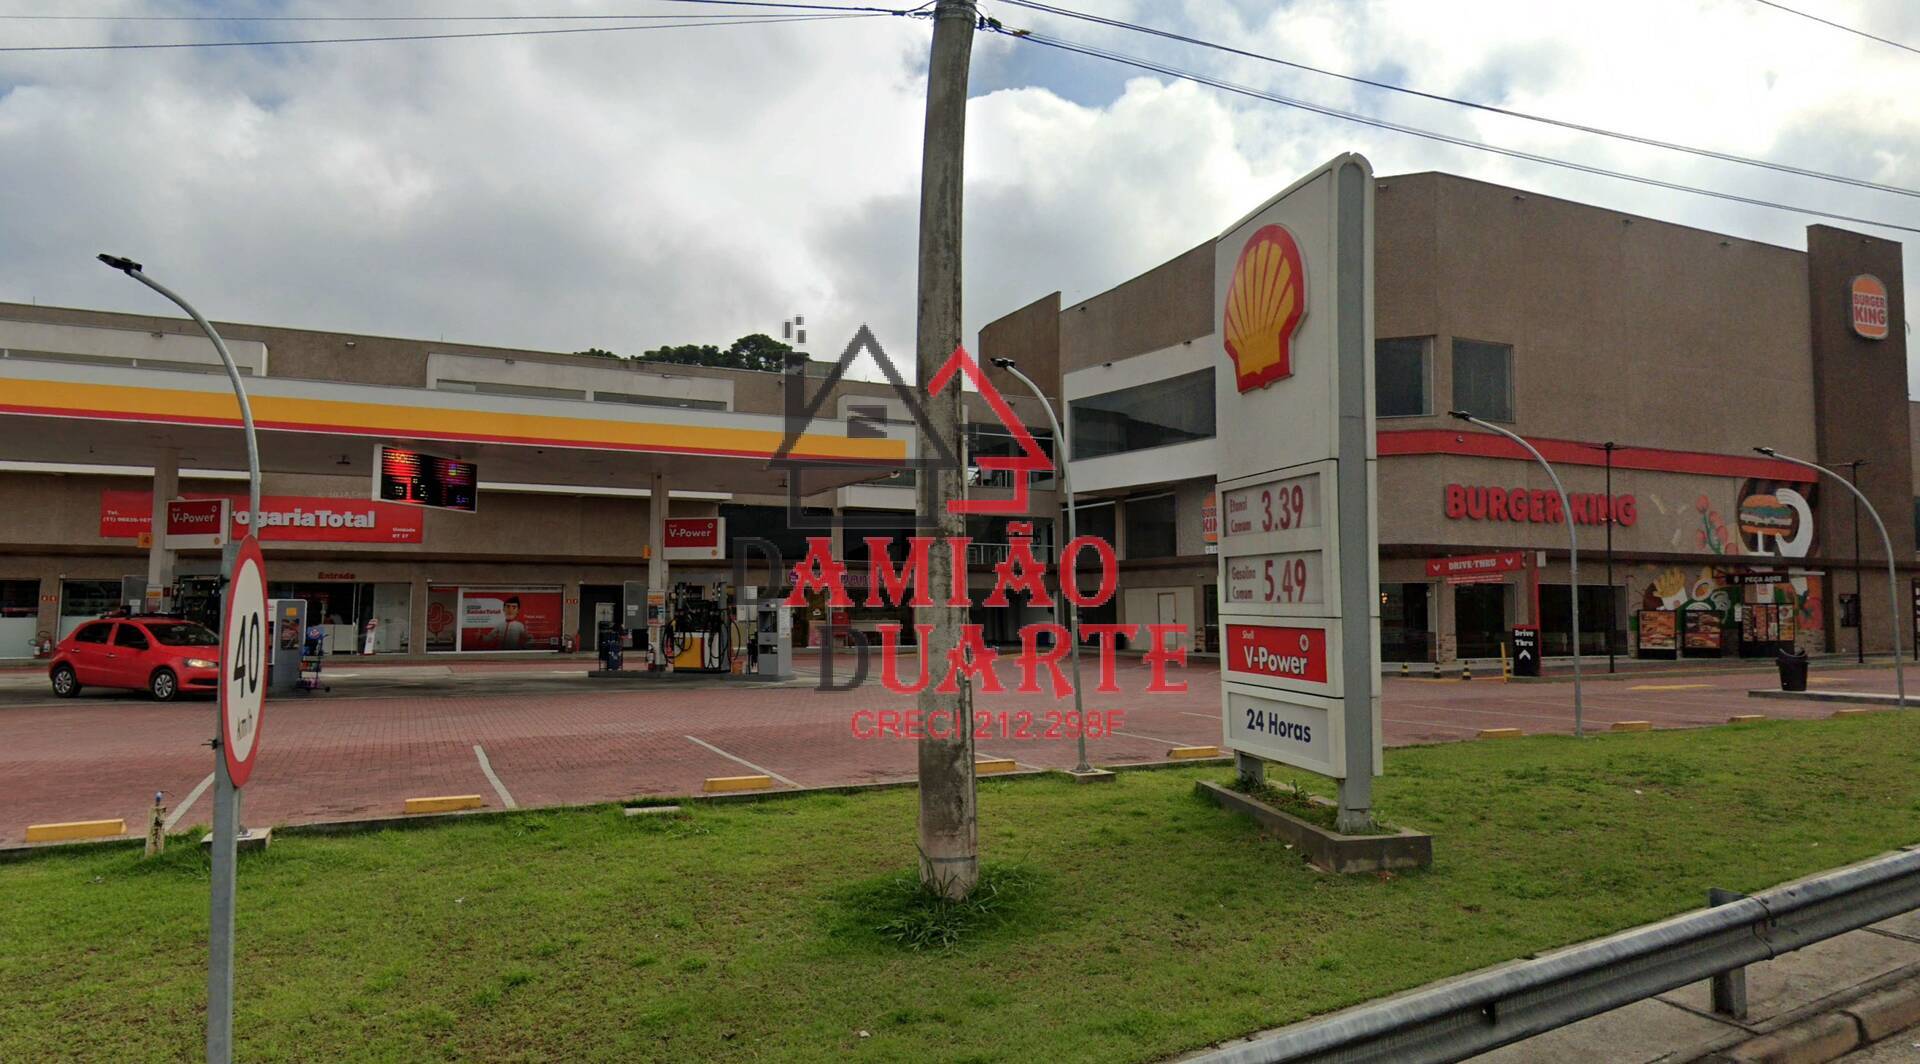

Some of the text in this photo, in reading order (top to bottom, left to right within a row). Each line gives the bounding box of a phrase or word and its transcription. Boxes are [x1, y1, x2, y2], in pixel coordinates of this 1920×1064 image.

[1854, 293, 1885, 308] BURGER
[1855, 306, 1886, 325] KING
[1262, 485, 1304, 532] 3.39
[1446, 484, 1637, 526] BURGER KING
[172, 513, 215, 523] V-Power
[669, 528, 712, 538] V-Power
[1264, 558, 1306, 602] 5.49
[1514, 629, 1535, 638] Drive
[1514, 639, 1534, 647] Thru
[233, 611, 260, 698] 40
[1243, 646, 1308, 675] V-Power
[1246, 708, 1312, 743] 24 Horas
